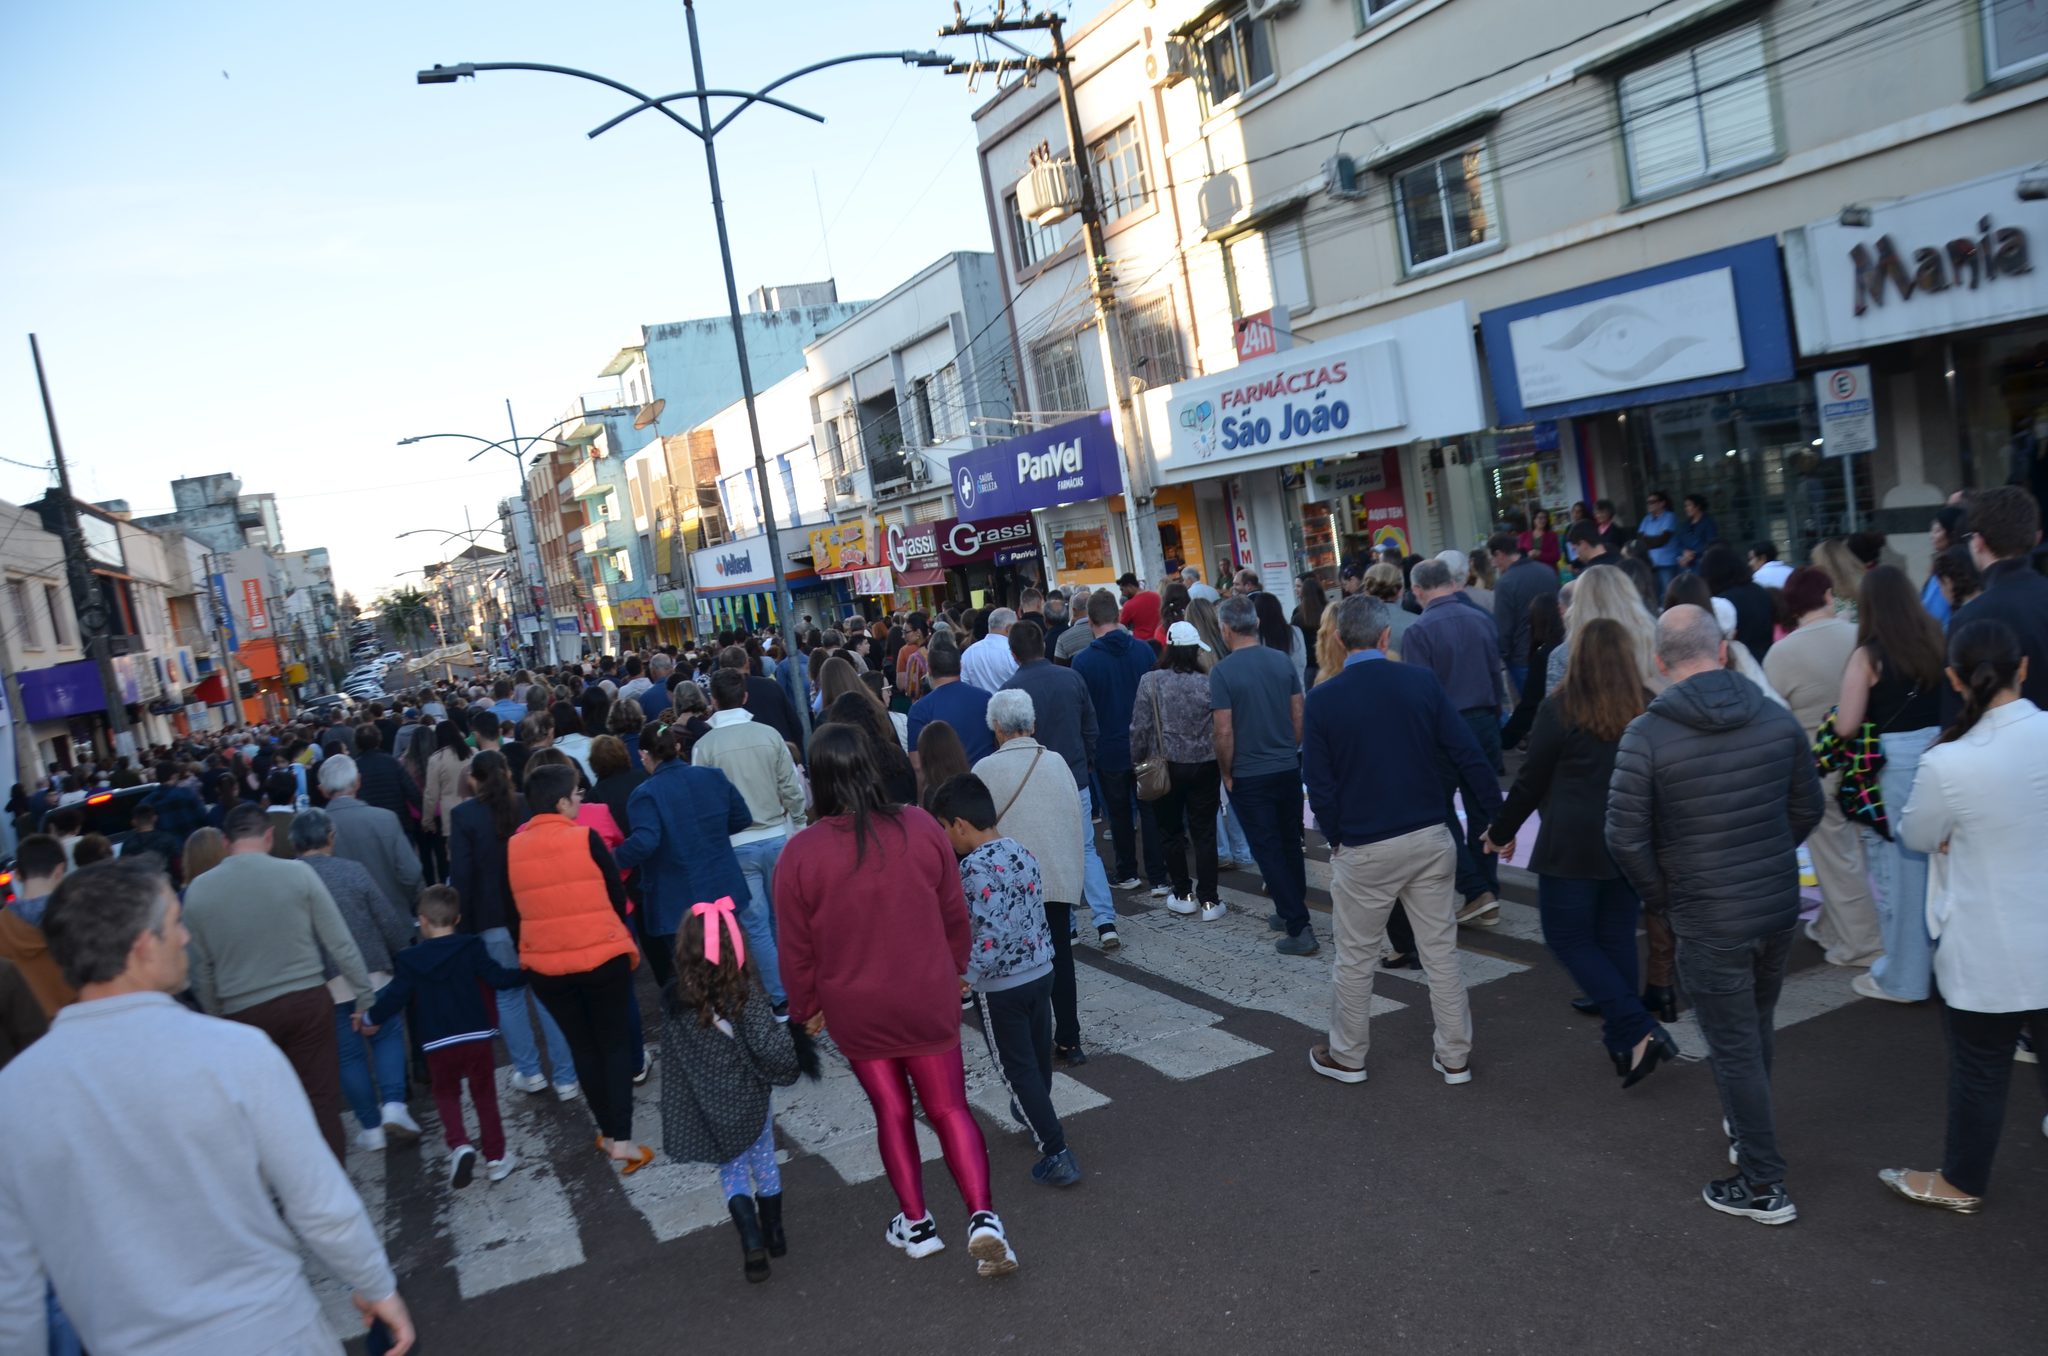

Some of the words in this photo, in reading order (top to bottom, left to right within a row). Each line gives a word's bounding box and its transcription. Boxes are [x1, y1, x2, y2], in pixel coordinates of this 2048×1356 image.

[1849, 212, 2034, 317] Mania
[1240, 319, 1273, 355] 24h
[1221, 361, 1348, 410] FARMÁCIAS
[1837, 375, 1851, 393] E
[1221, 407, 1271, 450] São
[1279, 389, 1350, 441] João
[1017, 437, 1083, 484] PanVel
[981, 481, 998, 494] BELEZA
[1058, 475, 1084, 491] FARMÁCIAS
[887, 523, 937, 573] Grassi
[942, 519, 1032, 556] Grassi
[1011, 549, 1037, 560] PanVel
